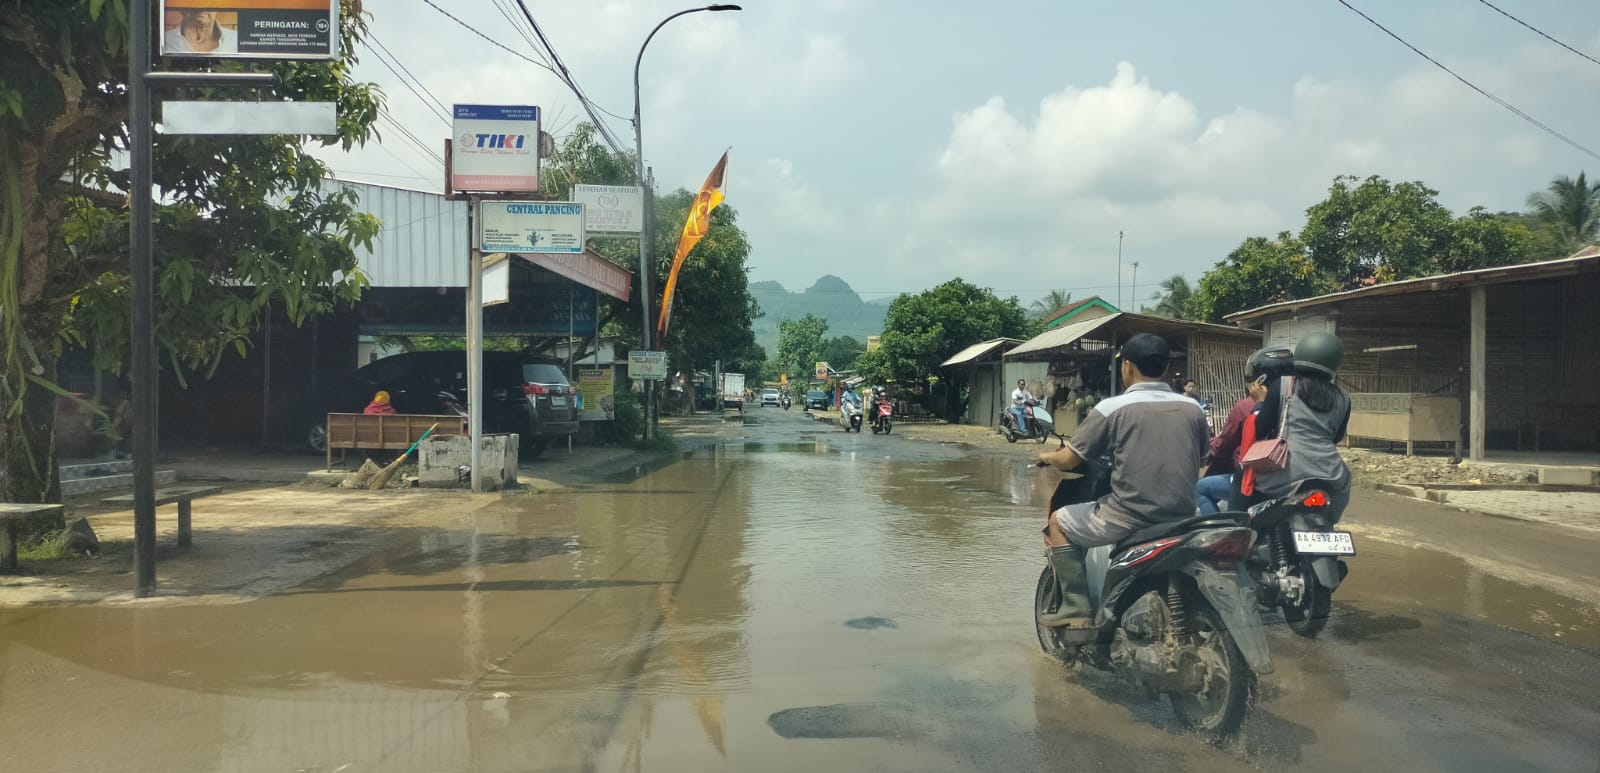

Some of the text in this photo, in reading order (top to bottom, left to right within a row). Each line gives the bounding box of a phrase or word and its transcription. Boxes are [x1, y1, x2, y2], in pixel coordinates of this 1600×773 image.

[254, 20, 310, 29] PERINGATAN:
[475, 133, 525, 149] TIKI
[506, 204, 544, 214] CENTRAL
[545, 204, 581, 215] PANCING
[1297, 533, 1309, 542] AA
[1311, 533, 1332, 543] 4932
